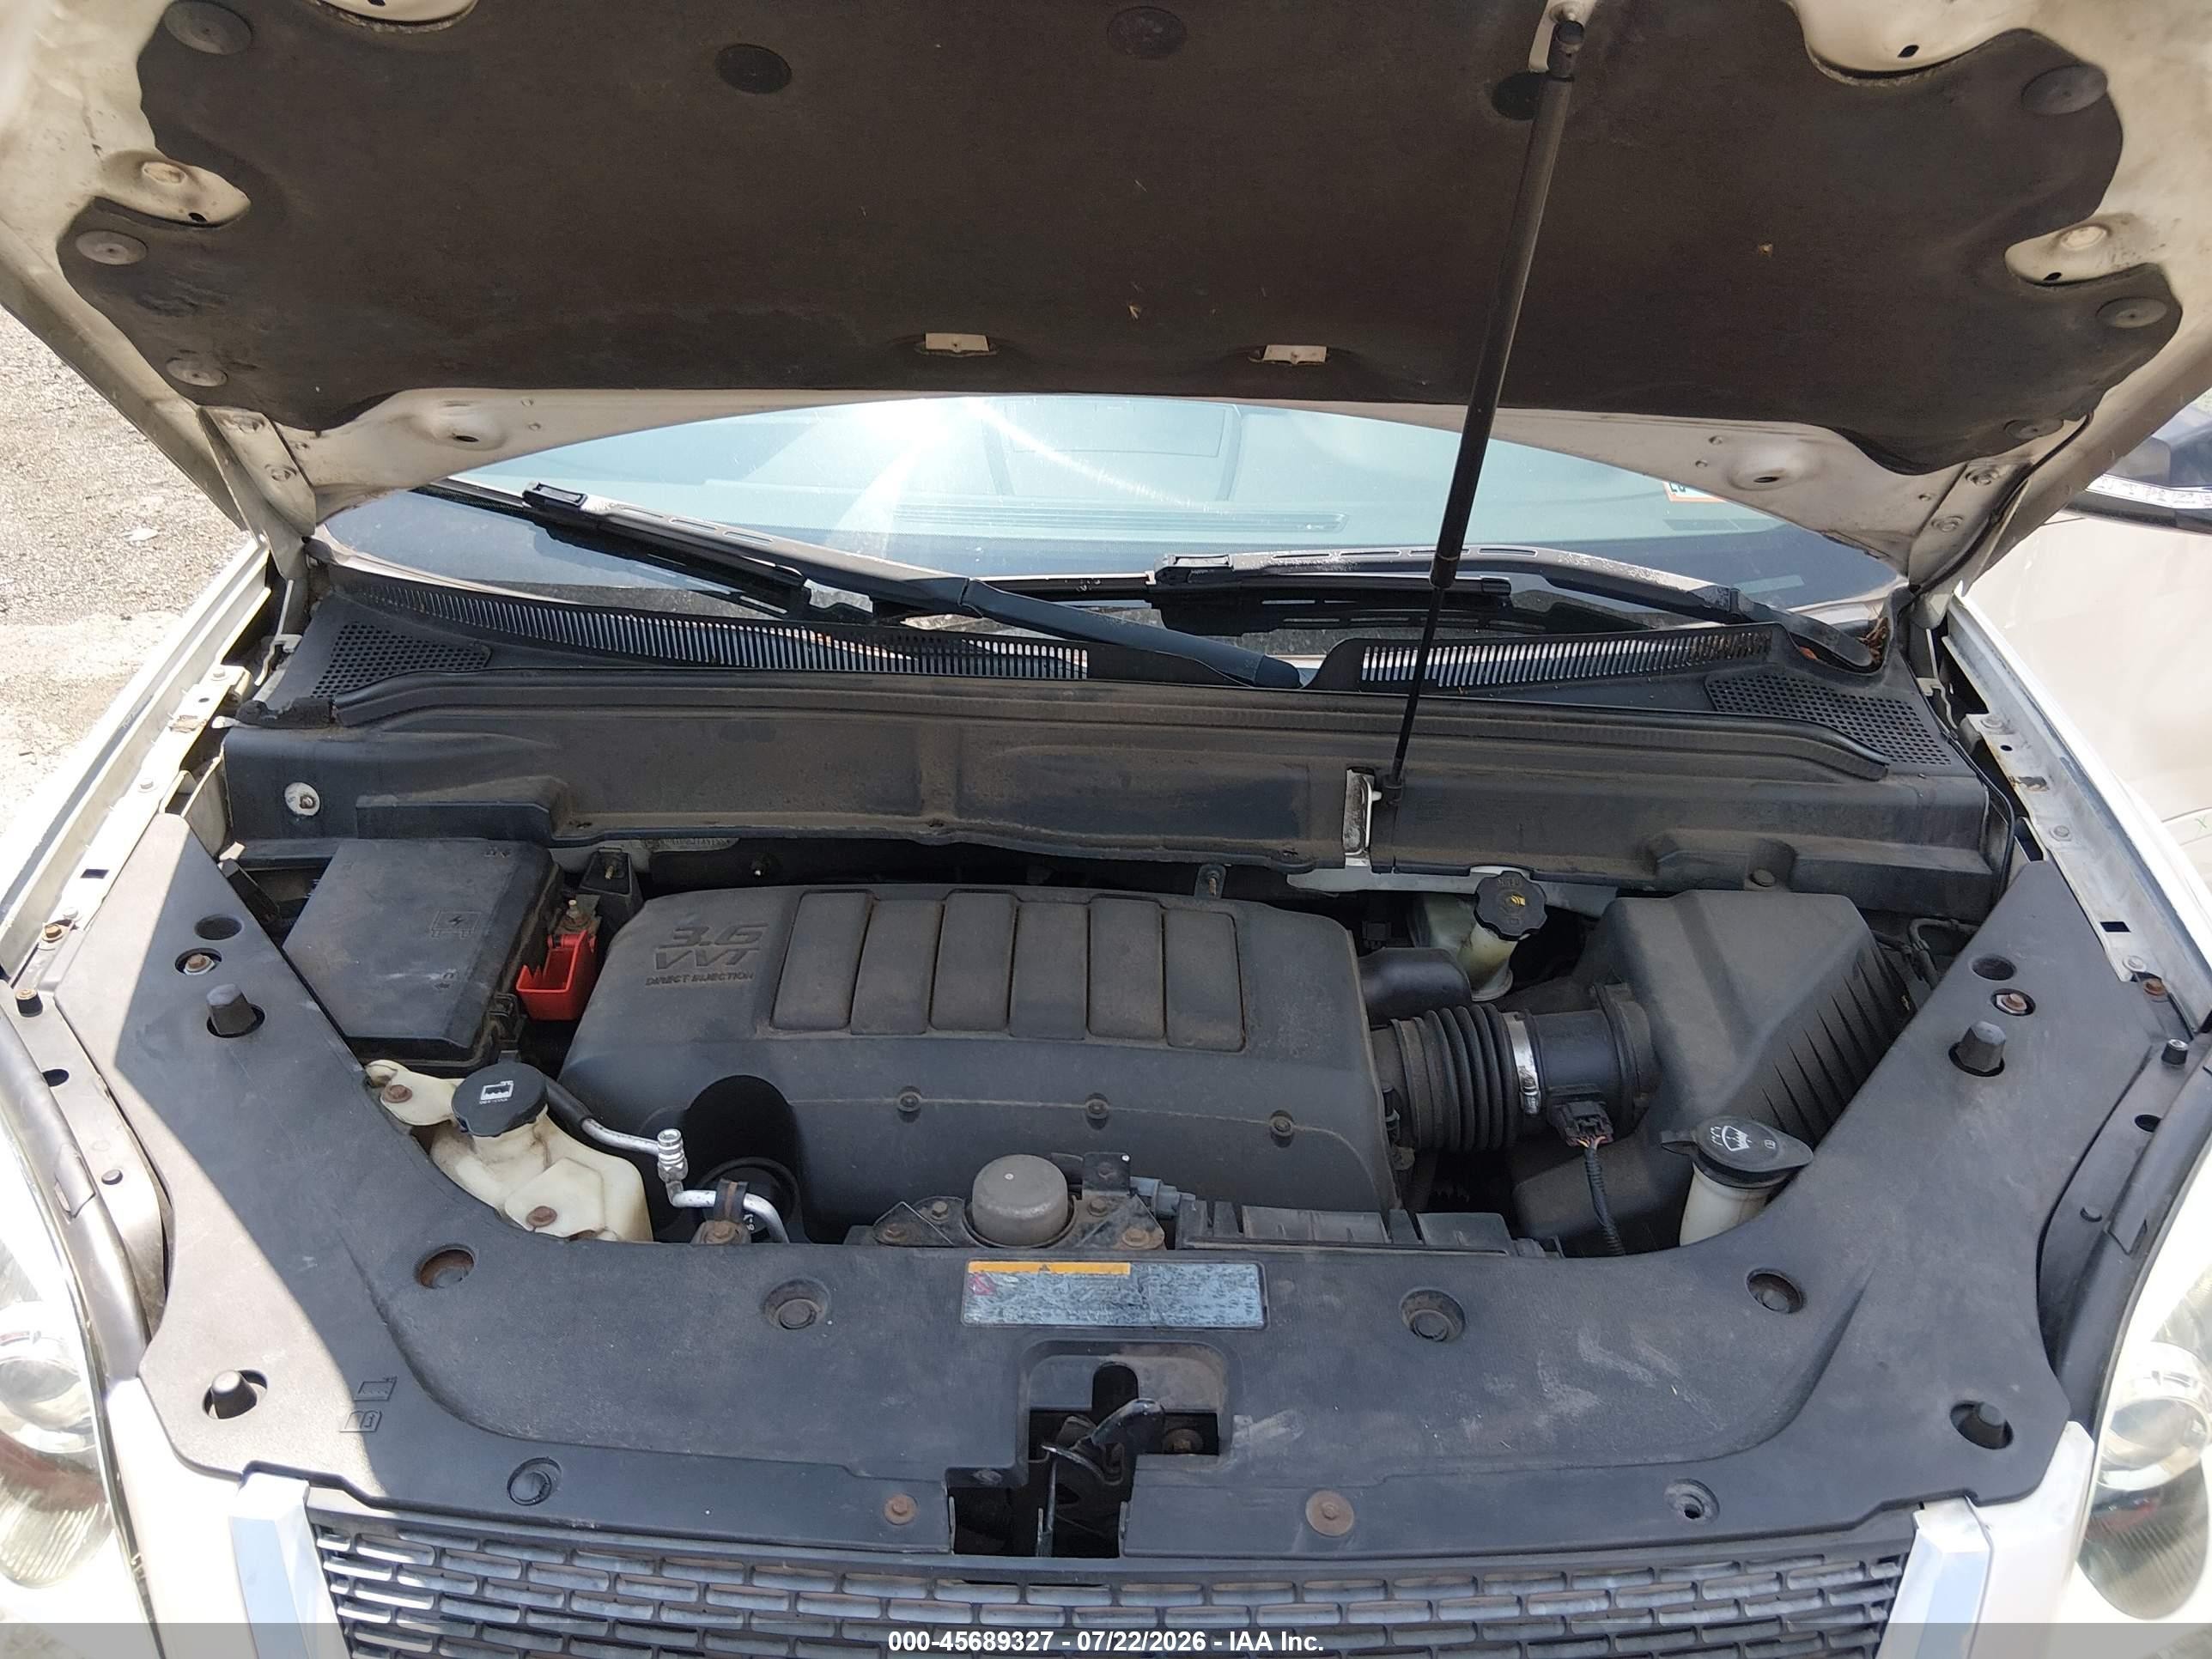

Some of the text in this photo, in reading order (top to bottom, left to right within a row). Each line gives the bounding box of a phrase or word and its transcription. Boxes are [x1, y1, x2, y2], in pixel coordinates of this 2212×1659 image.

[657, 925, 769, 949] 3.6
[655, 947, 760, 970] VVT
[645, 971, 755, 986] DIRECT INJECTION
